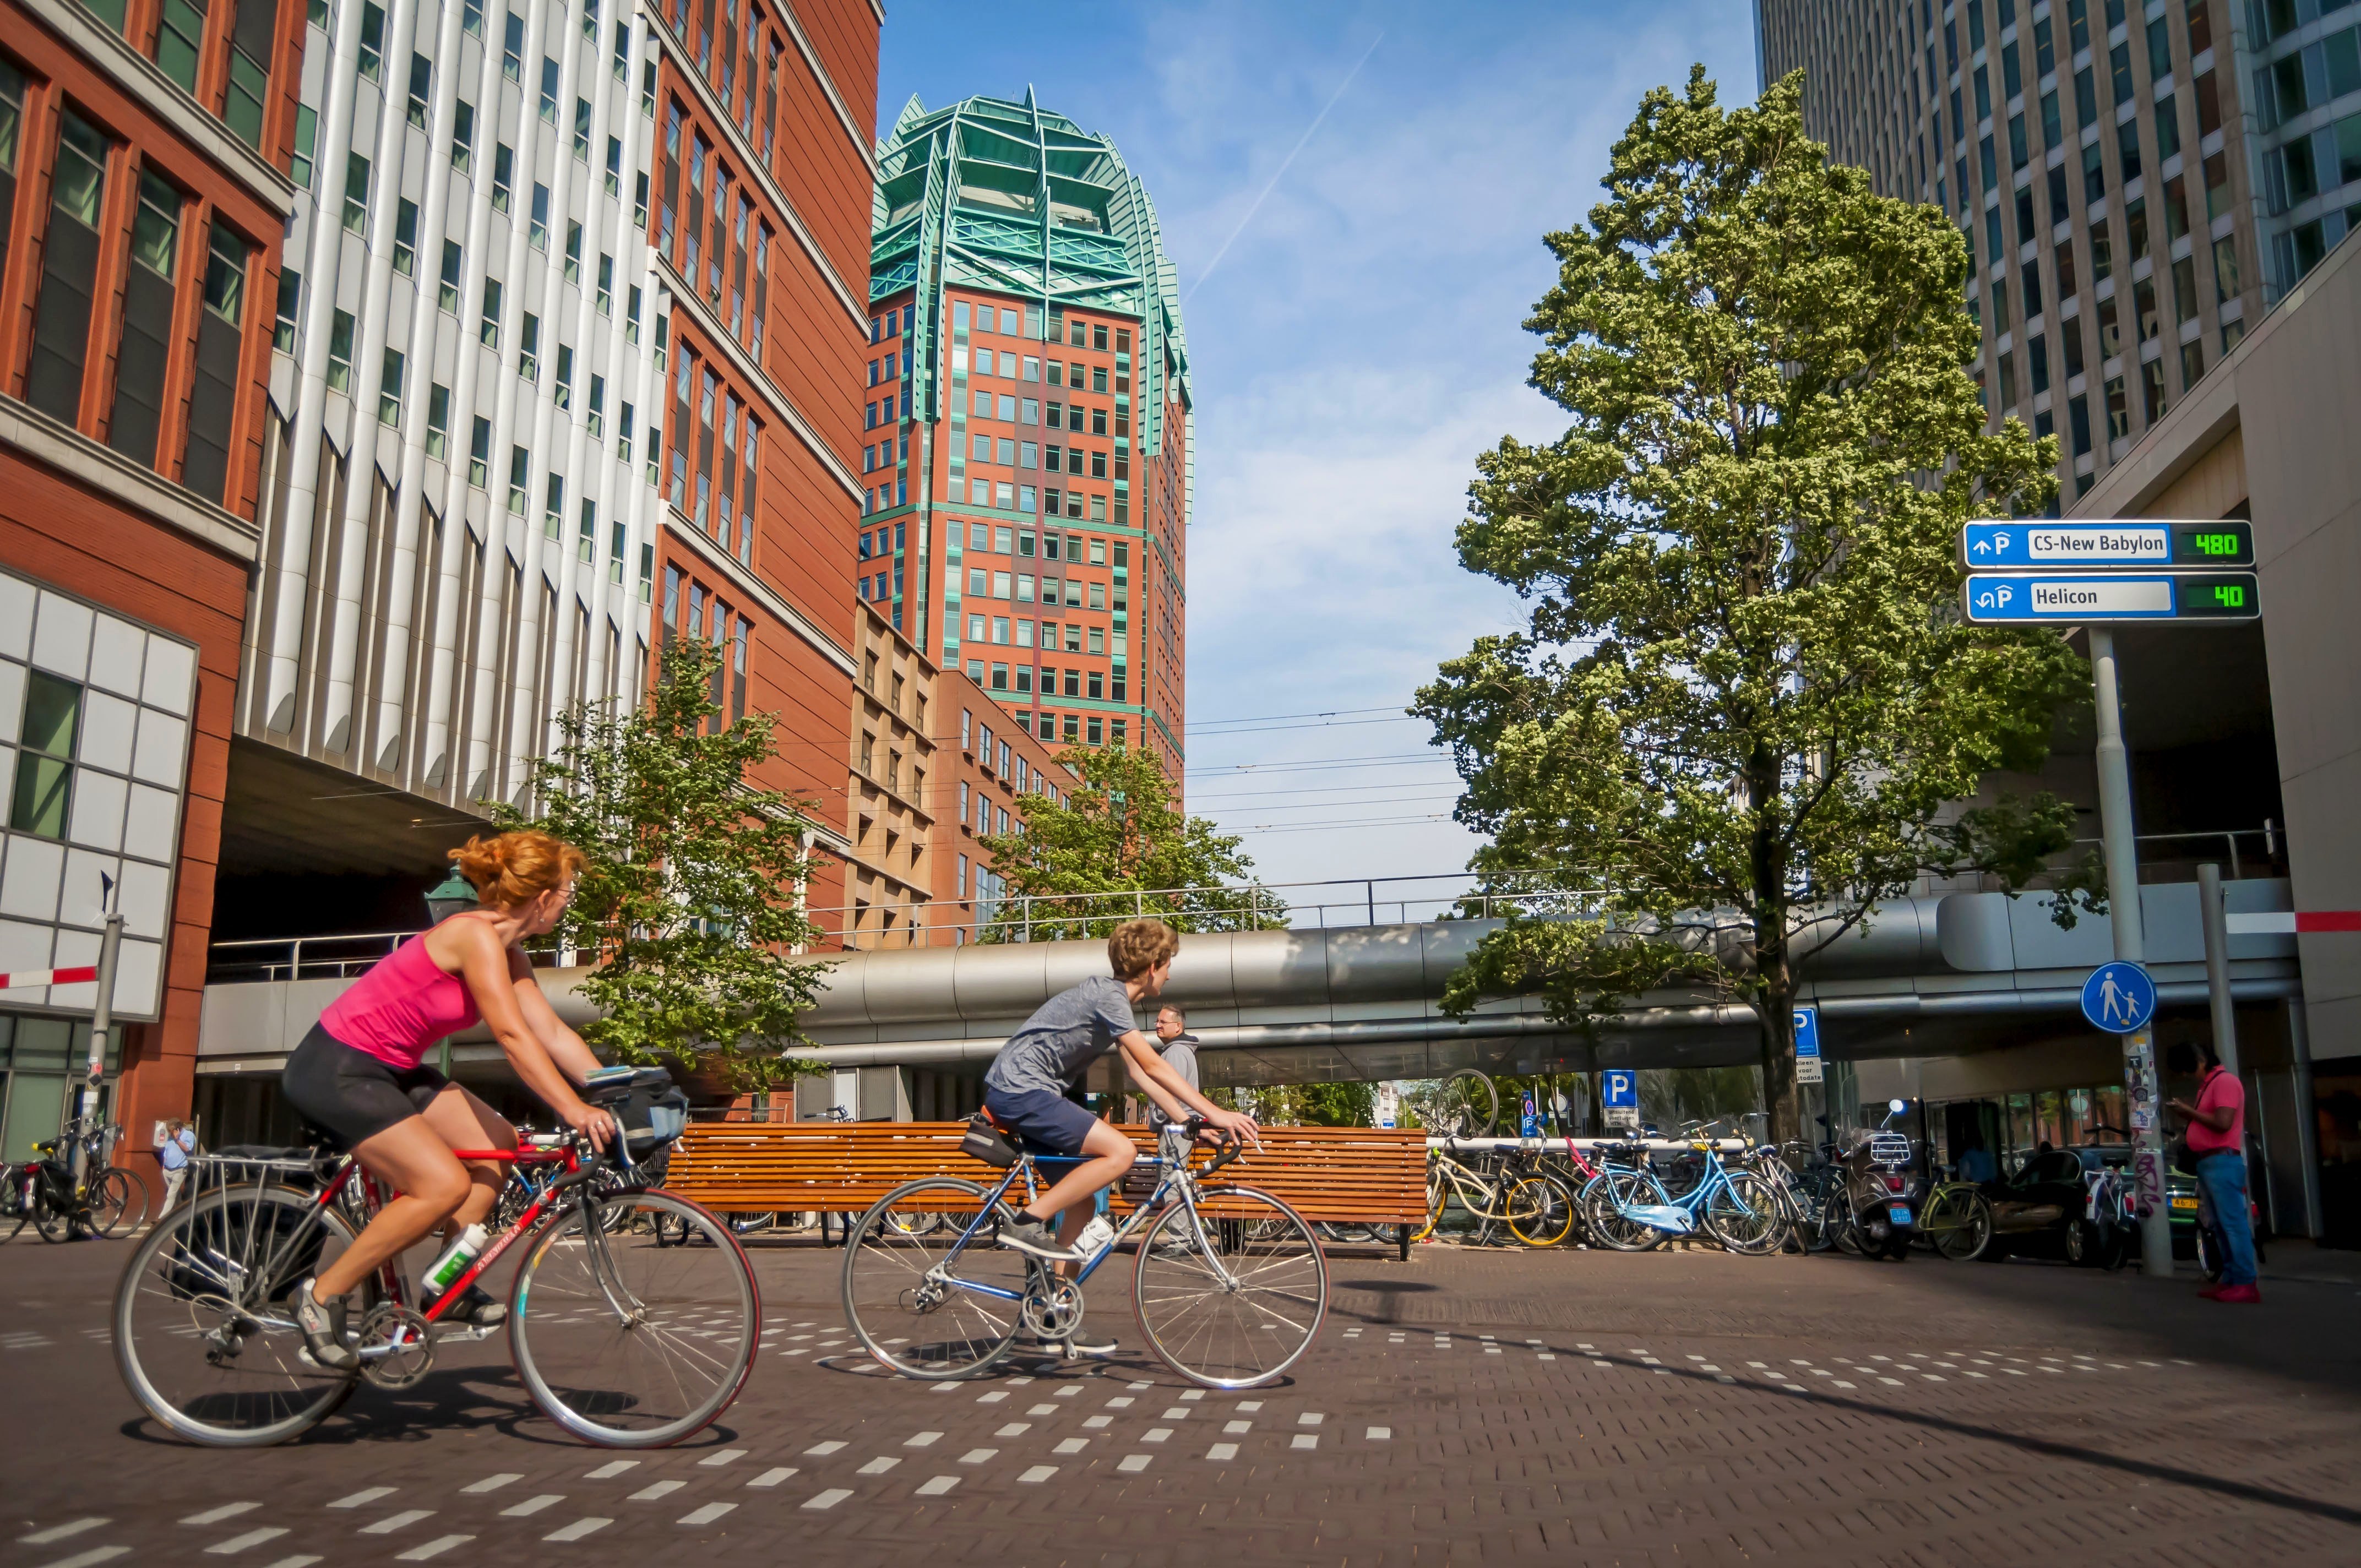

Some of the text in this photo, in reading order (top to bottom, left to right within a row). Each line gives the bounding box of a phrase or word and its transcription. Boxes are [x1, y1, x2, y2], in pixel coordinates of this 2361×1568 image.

[1995, 535, 2163, 555] P CS-New Babylon
[2196, 534, 2238, 555] 480
[1998, 589, 2097, 608] P Helicon
[2215, 586, 2243, 607] 40
[1611, 1075, 1629, 1102] P
[1526, 1120, 1533, 1129] P
